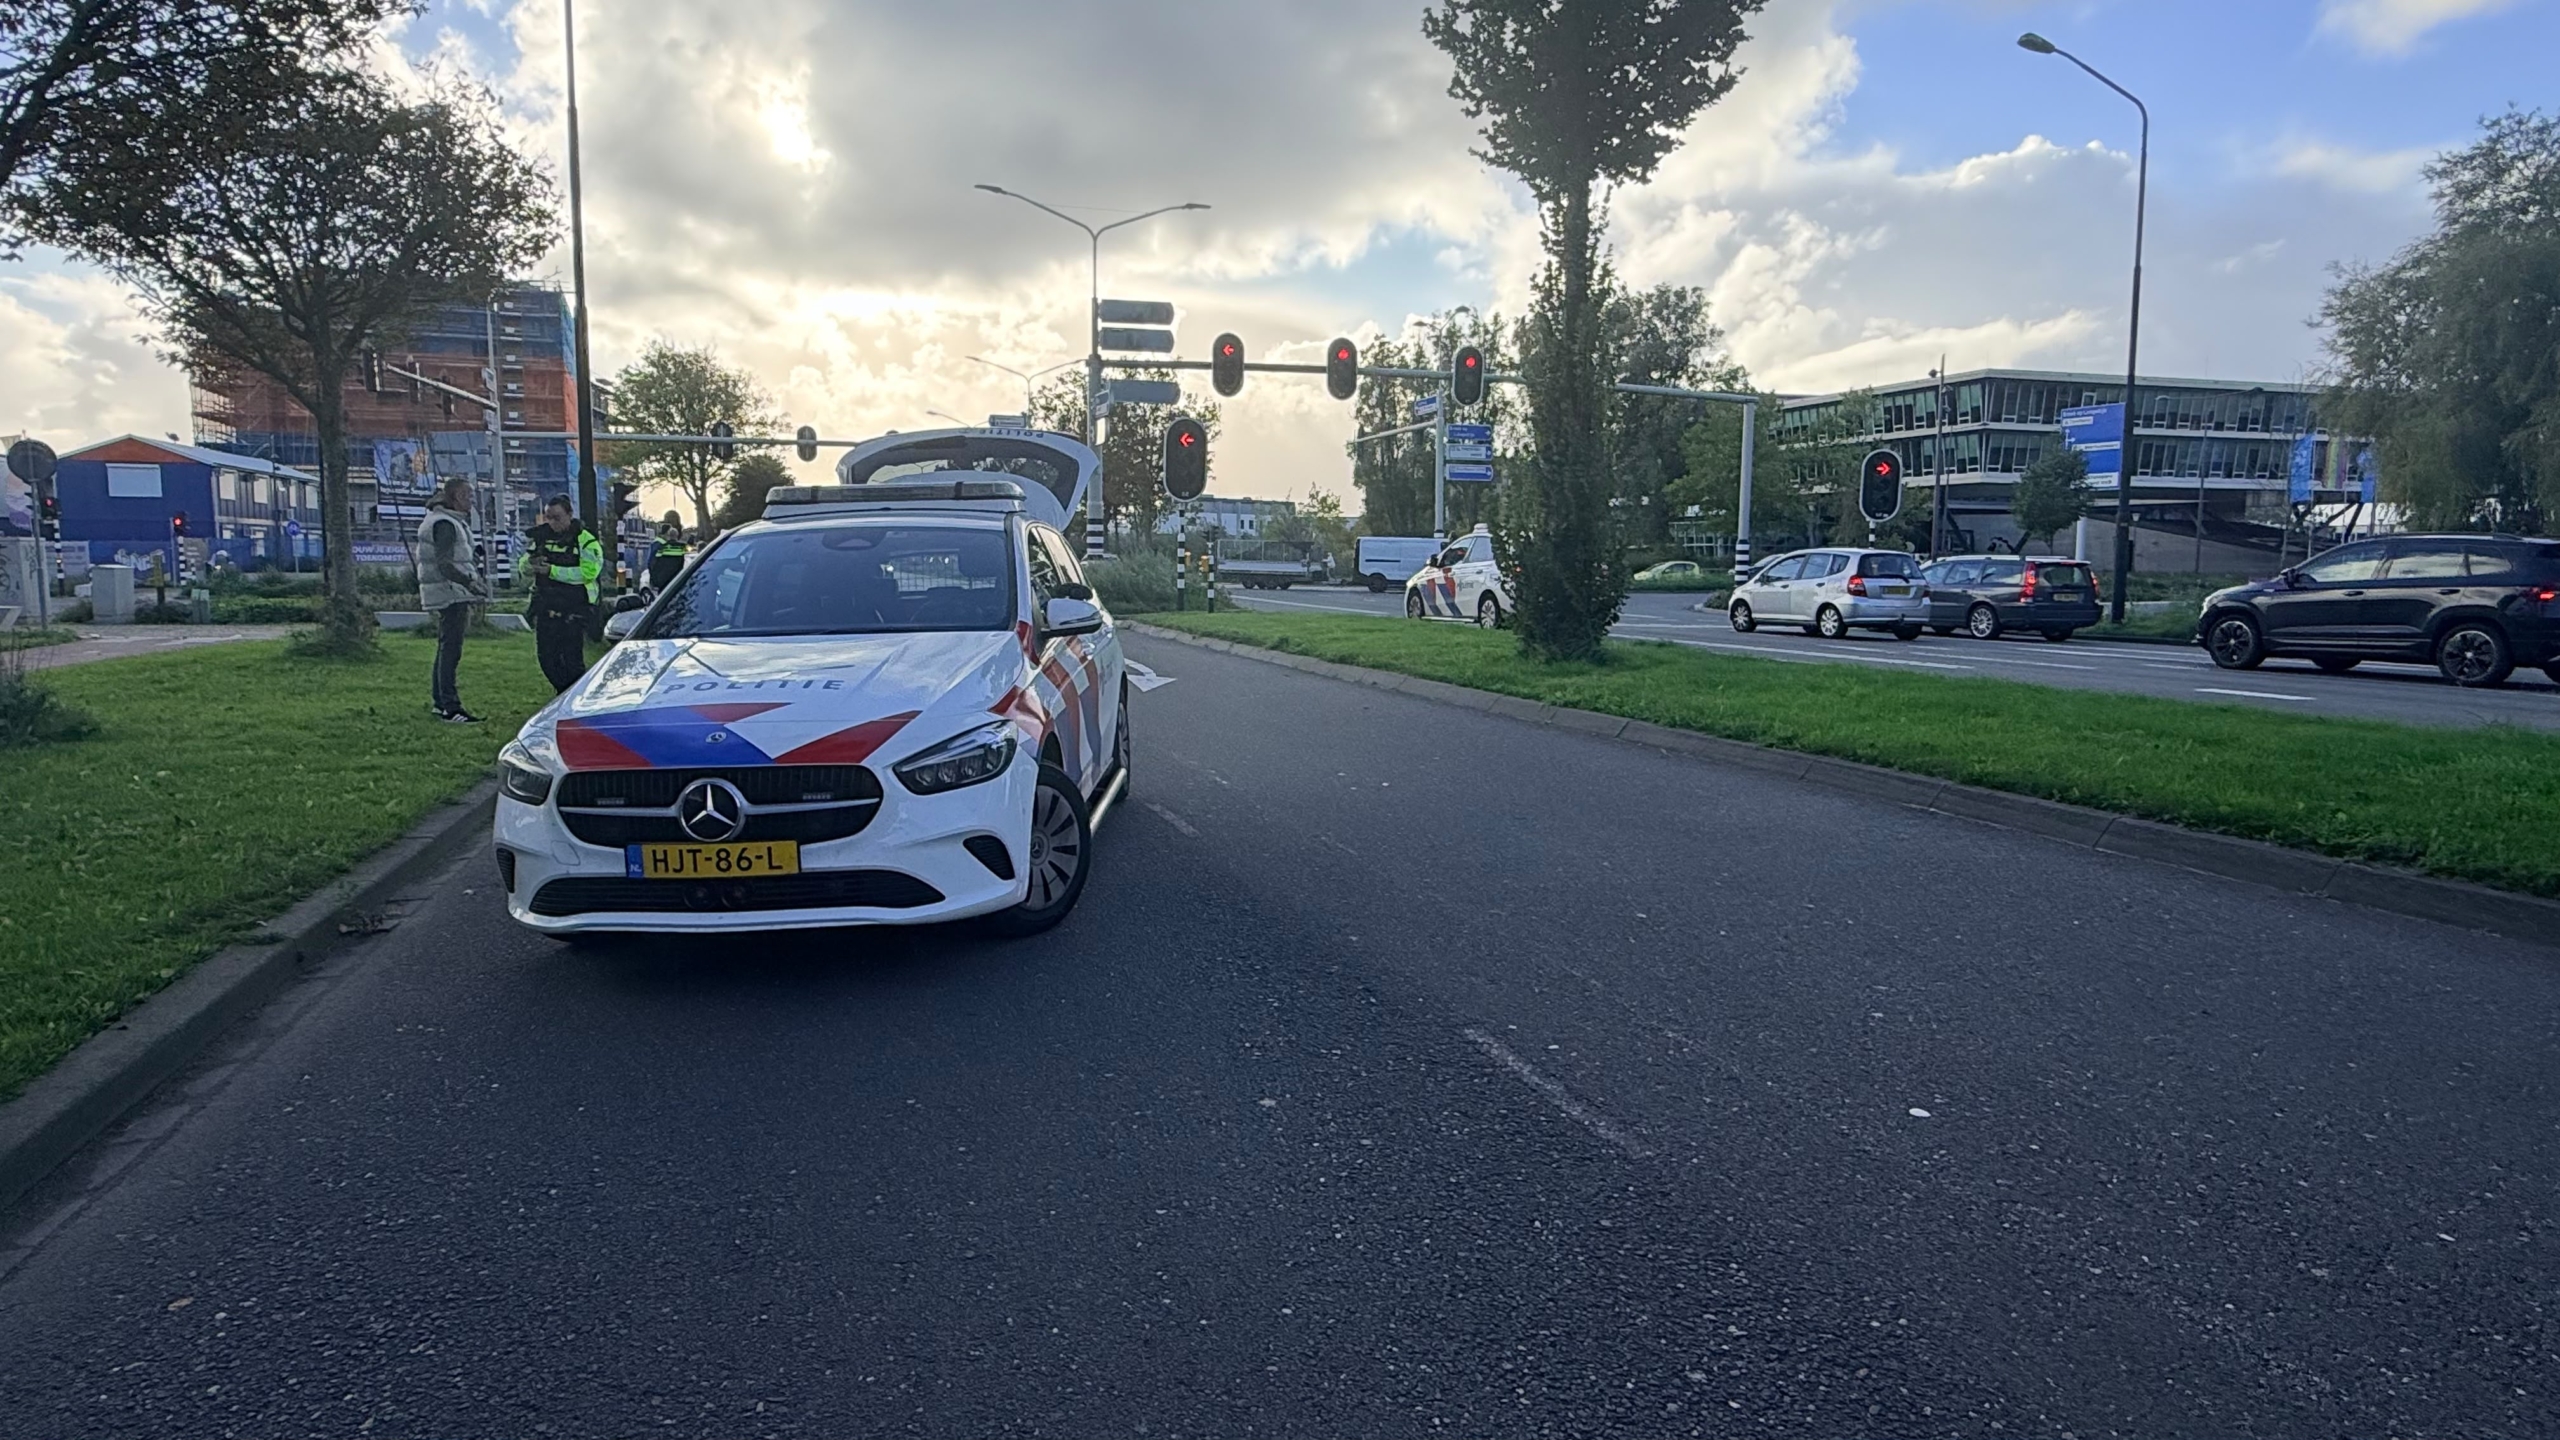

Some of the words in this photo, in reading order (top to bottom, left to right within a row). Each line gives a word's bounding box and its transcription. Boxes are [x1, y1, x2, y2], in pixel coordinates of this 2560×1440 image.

[662, 679, 845, 694] POLITIE
[651, 845, 784, 874] HJT-86-L
[629, 863, 642, 872] NL
